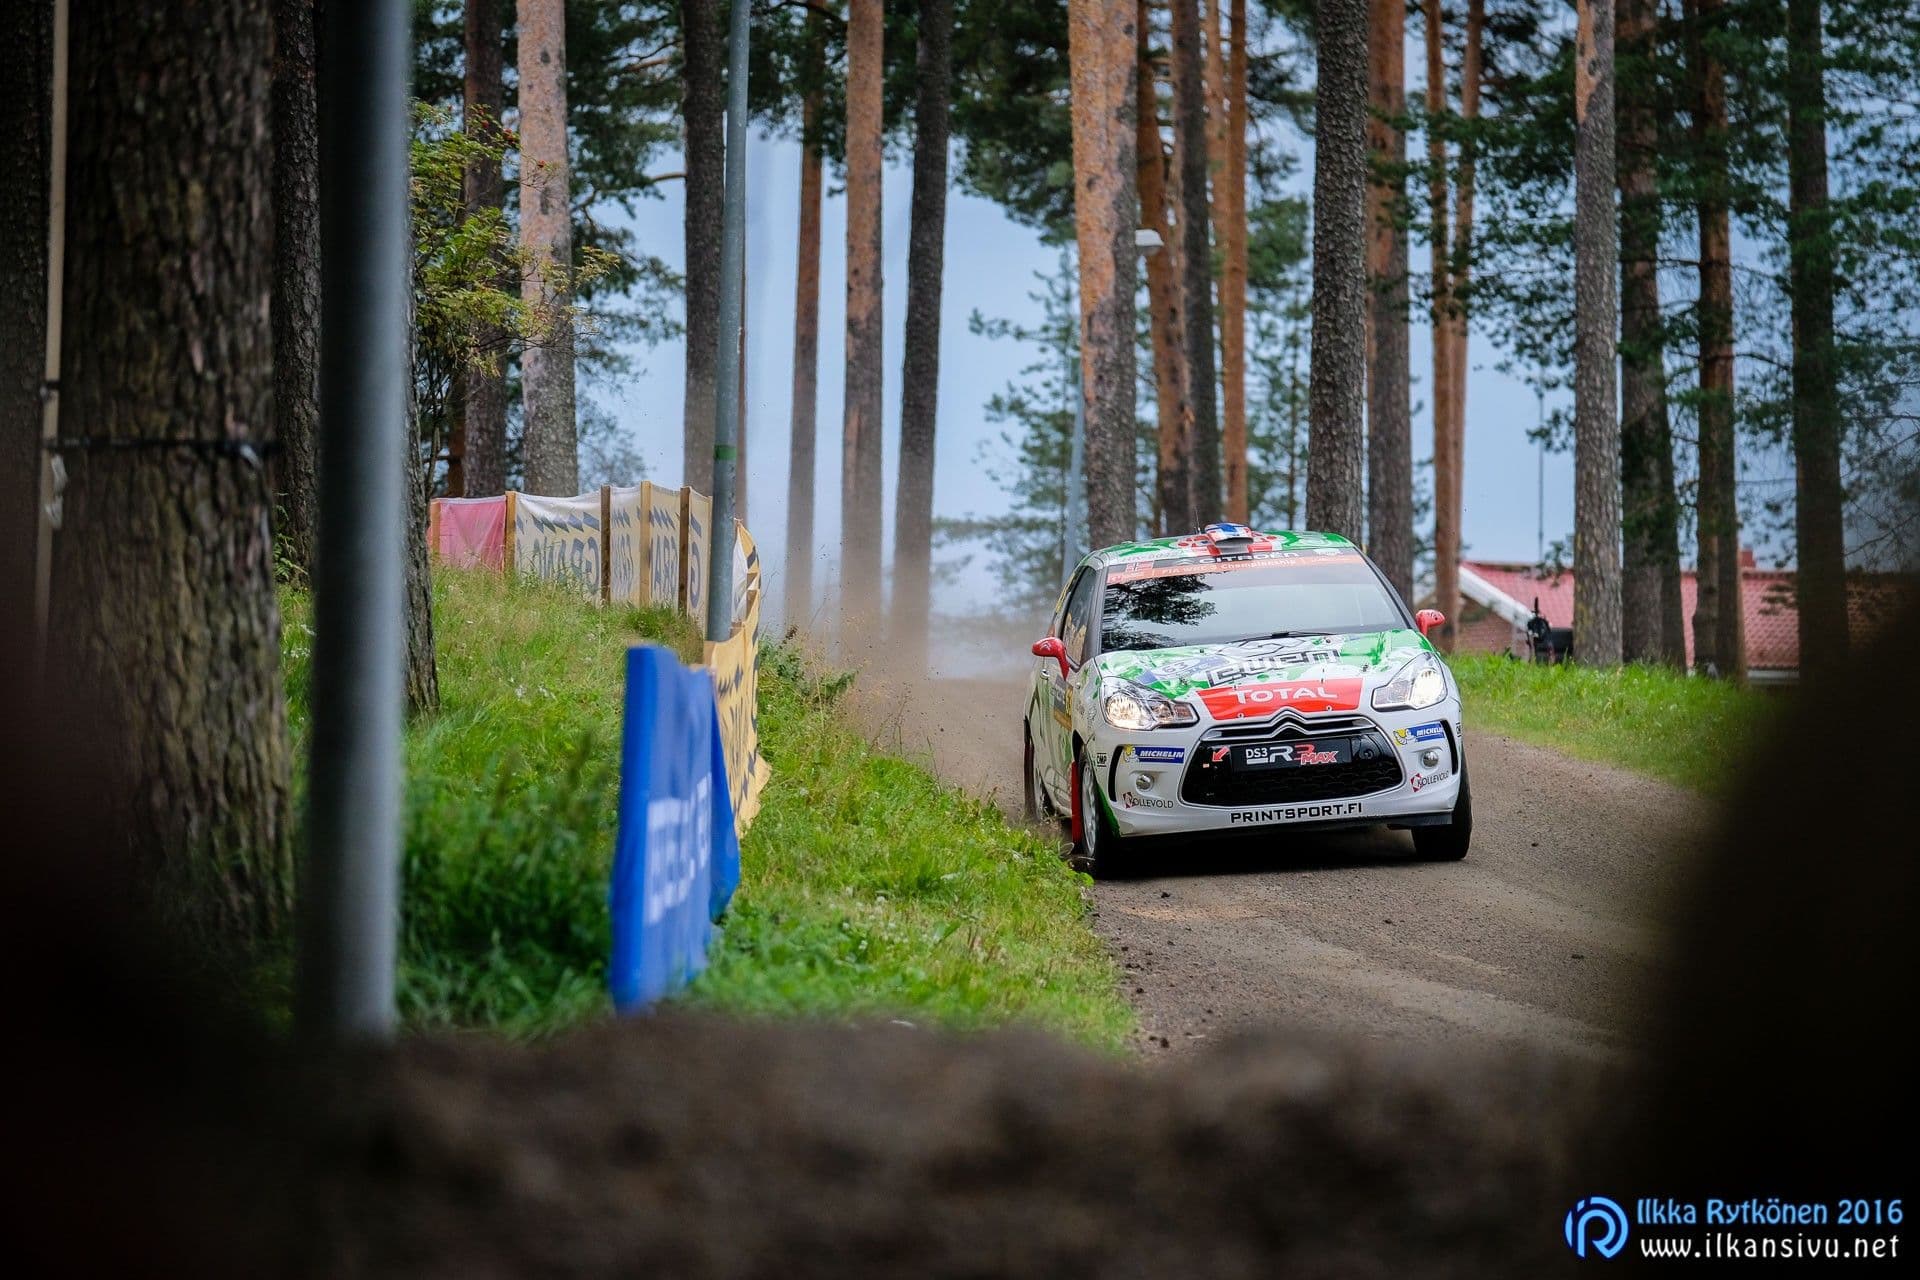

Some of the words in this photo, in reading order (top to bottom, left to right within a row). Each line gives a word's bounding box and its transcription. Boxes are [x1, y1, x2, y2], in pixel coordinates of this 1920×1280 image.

[1220, 558, 1298, 569] Championship
[1228, 686, 1338, 704] TOTAL
[1140, 750, 1185, 759] MICHELIN
[1245, 747, 1268, 759] DS3
[1230, 803, 1362, 823] PRINTSPORT.FI
